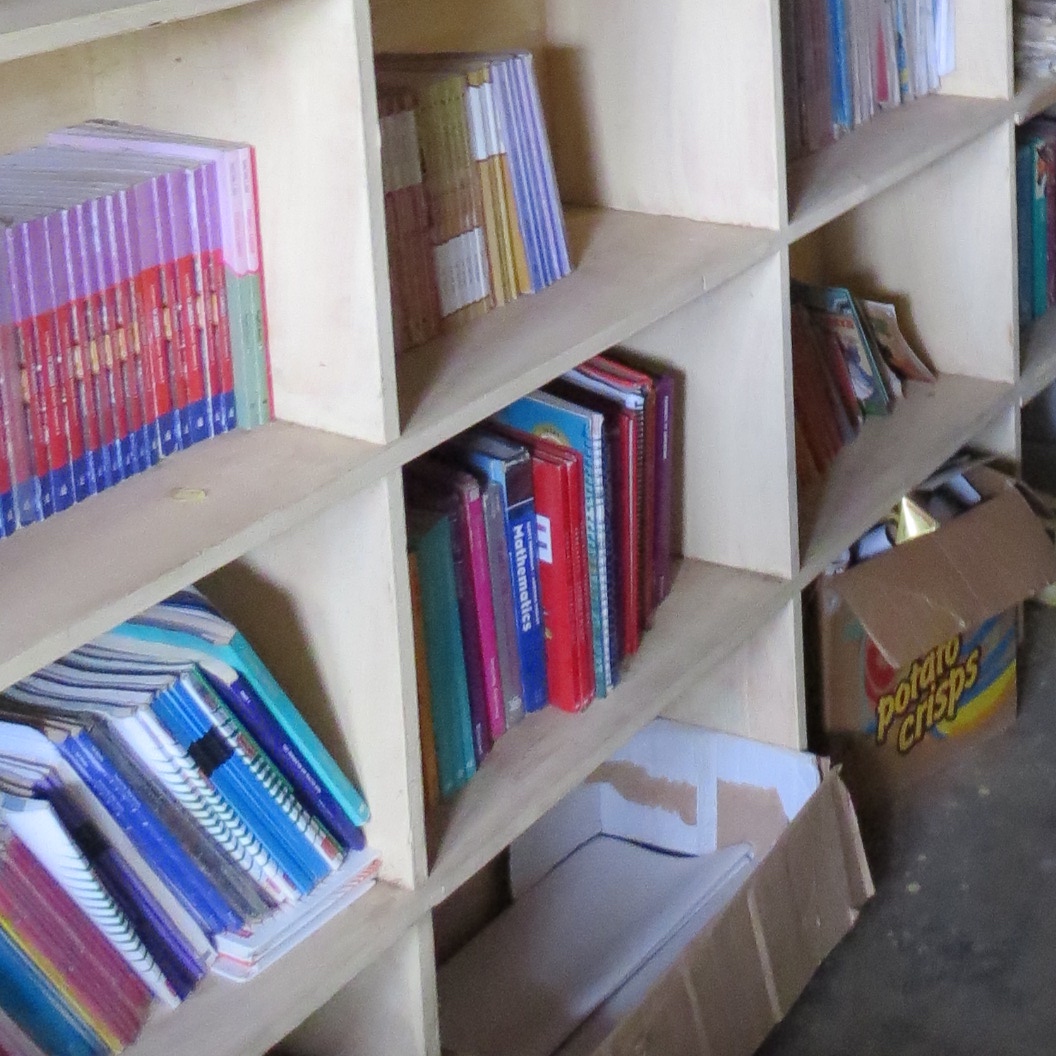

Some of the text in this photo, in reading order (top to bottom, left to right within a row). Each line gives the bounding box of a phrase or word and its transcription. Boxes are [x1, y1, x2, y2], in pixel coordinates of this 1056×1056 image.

[513, 523, 533, 633] Mathematics
[875, 631, 962, 746] potato
[897, 645, 982, 755] crisps
